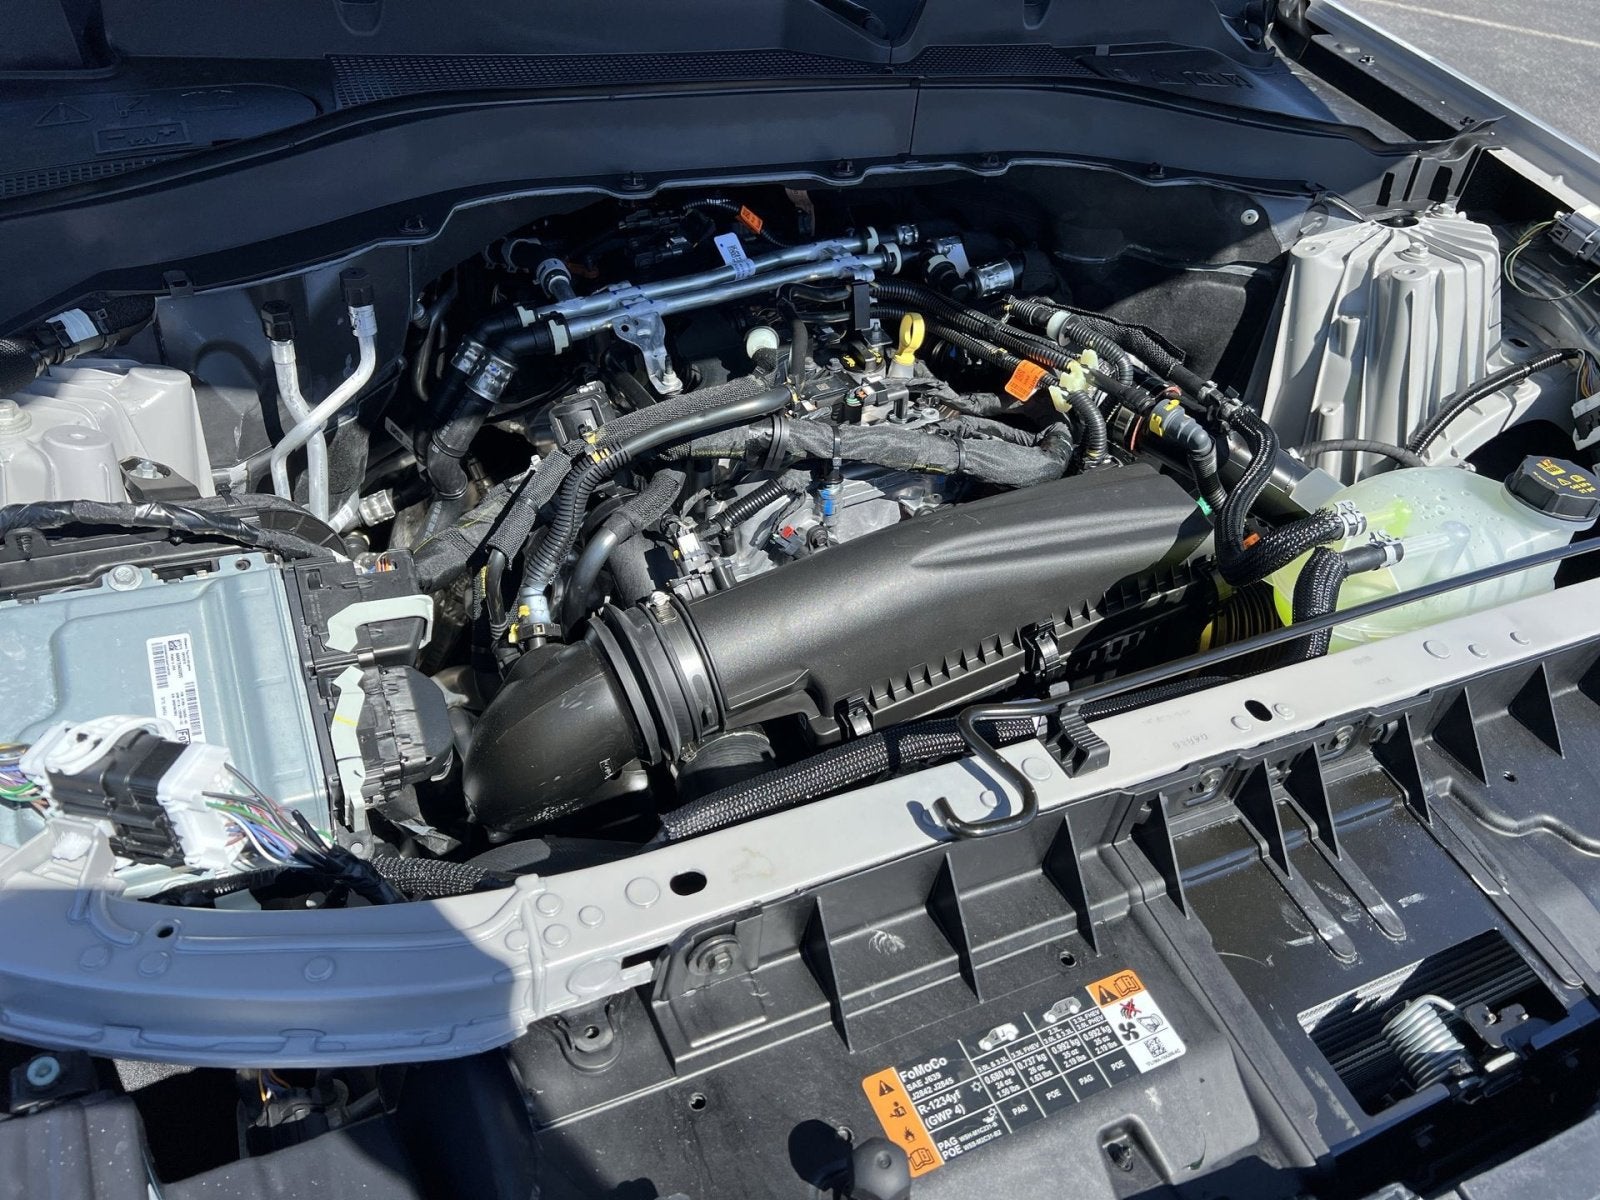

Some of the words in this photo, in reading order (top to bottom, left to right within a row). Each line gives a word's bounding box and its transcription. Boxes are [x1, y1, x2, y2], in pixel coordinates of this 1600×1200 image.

[1082, 1028, 1101, 1041] 0.992
[1100, 1025, 1112, 1034] kg
[1102, 1035, 1111, 1043] oz
[1051, 1041, 1071, 1055] 0.992
[1070, 1037, 1081, 1047] kg
[1062, 1050, 1071, 1059] 35
[1071, 1048, 1079, 1056] oz
[899, 1057, 948, 1082] FoMoCo
[1017, 1056, 1036, 1070] 0.737
[1035, 1053, 1048, 1062] kg
[1110, 1060, 1126, 1071] POE
[906, 1079, 924, 1092] SAE
[924, 1072, 942, 1085] J639
[984, 1070, 1004, 1084] 0.680
[1003, 1067, 1016, 1076] kg
[1078, 1074, 1095, 1086] PAG
[912, 1087, 933, 1100] J2842
[933, 1077, 955, 1091] J2845
[995, 1081, 1005, 1090] 24
[1004, 1078, 1013, 1086] oz
[917, 1089, 961, 1115] R-1234yf
[1045, 1088, 1062, 1101] POE
[924, 1108, 953, 1129] (GWP
[954, 1103, 966, 1115] 4)
[1011, 1103, 1028, 1116] PAG
[937, 1136, 958, 1151] PAG
[942, 1144, 963, 1160] POE
